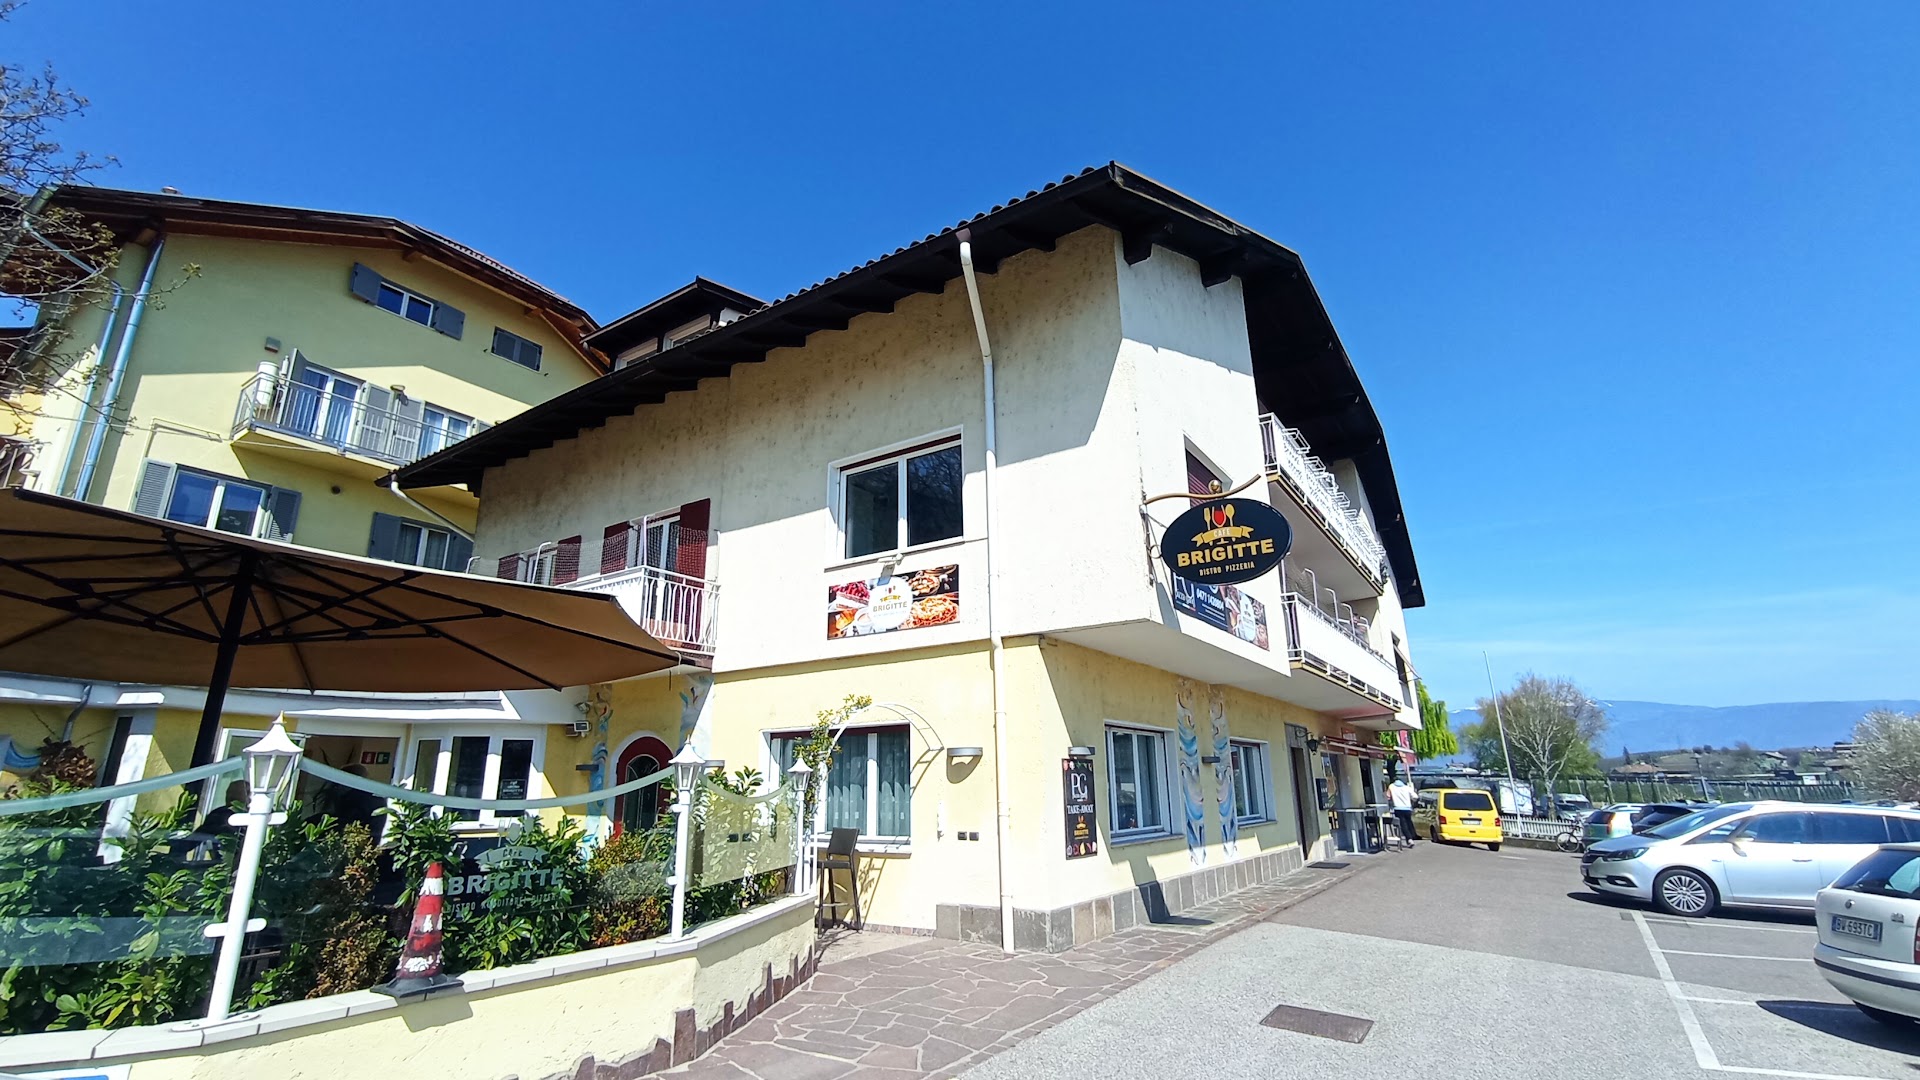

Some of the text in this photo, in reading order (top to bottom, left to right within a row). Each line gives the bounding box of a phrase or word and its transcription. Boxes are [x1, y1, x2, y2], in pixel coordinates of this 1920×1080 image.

[1177, 539, 1274, 567] BRIGITTE
[1225, 561, 1255, 572] PIZZERIA
[872, 601, 908, 613] BRIGITTE
[447, 868, 564, 895] BRIGITTE
